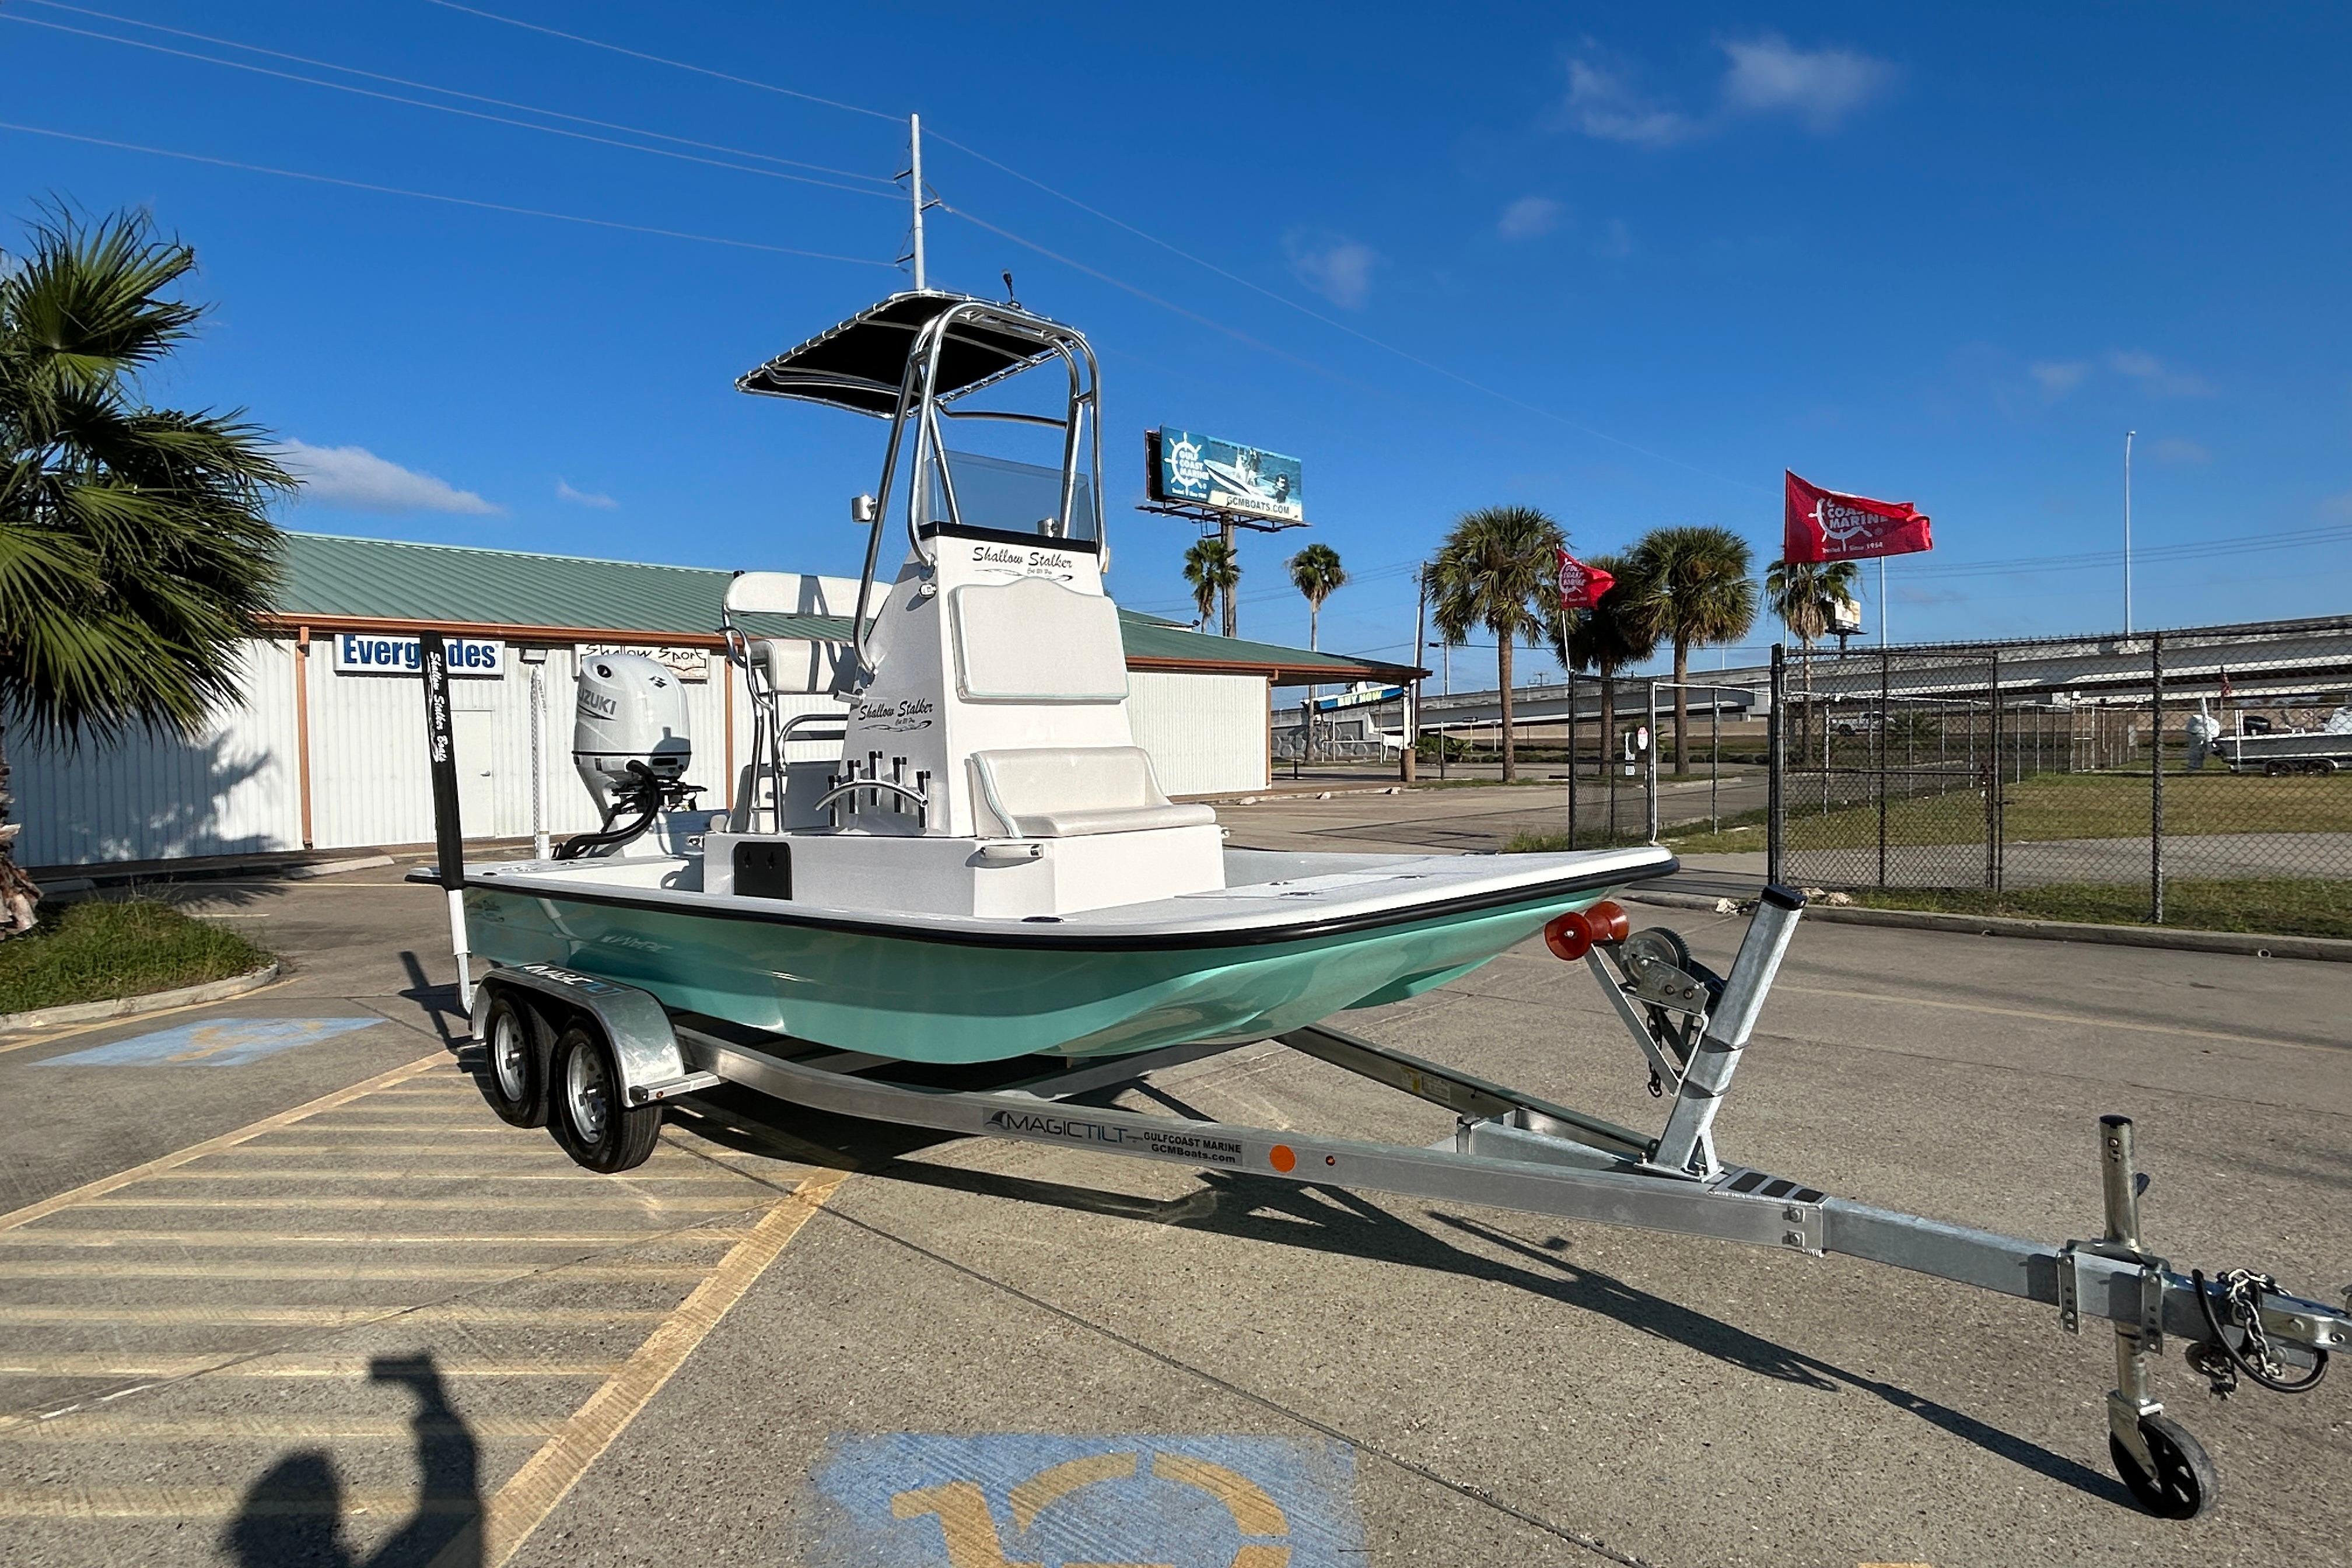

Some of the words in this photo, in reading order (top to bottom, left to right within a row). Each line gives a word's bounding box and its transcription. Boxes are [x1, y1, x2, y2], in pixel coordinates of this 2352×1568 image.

[1227, 496, 1290, 514] GCMBOATS.COM
[972, 546, 1024, 565] Shallow
[1028, 552, 1073, 569] Stalker
[343, 634, 496, 669] Evergdes
[578, 687, 617, 715] UZUKI
[858, 703, 895, 721] Shallow
[898, 698, 933, 718] Stalker
[1007, 1114, 1128, 1144] MAGICTILT
[1152, 1144, 1236, 1163] GCMBoats.com
[1203, 1140, 1241, 1154] MARINE
